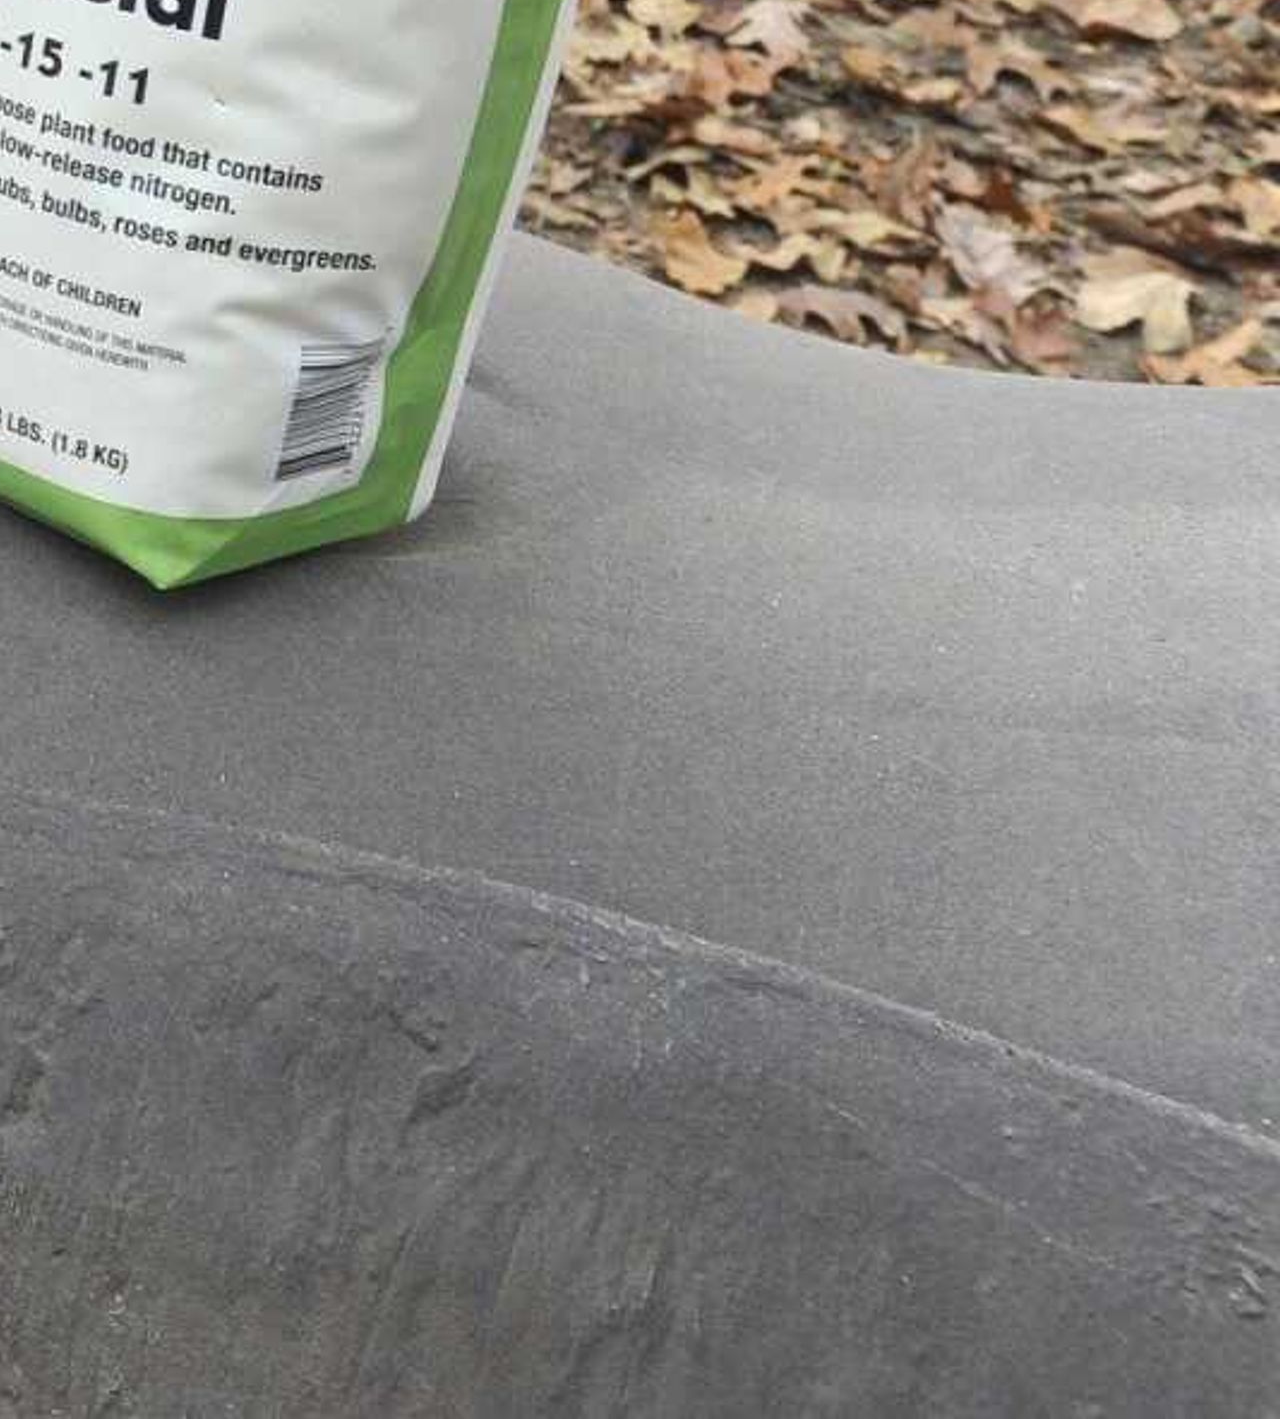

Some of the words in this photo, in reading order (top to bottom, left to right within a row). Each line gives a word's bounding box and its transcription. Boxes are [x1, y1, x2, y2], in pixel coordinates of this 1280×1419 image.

[39, 110, 97, 145] plant
[102, 127, 156, 159] food
[162, 140, 211, 172] that
[217, 157, 324, 192] contains
[130, 172, 236, 215] nitrogen.
[41, 189, 107, 233] bulbs,
[114, 215, 178, 248] roses
[185, 233, 233, 257] and
[239, 242, 377, 273] evergreens.
[32, 268, 54, 290] OF
[56, 278, 142, 318] CHILDREN
[6, 411, 45, 445] LBS.
[51, 429, 88, 460] (1.8
[91, 443, 129, 475] KG)
